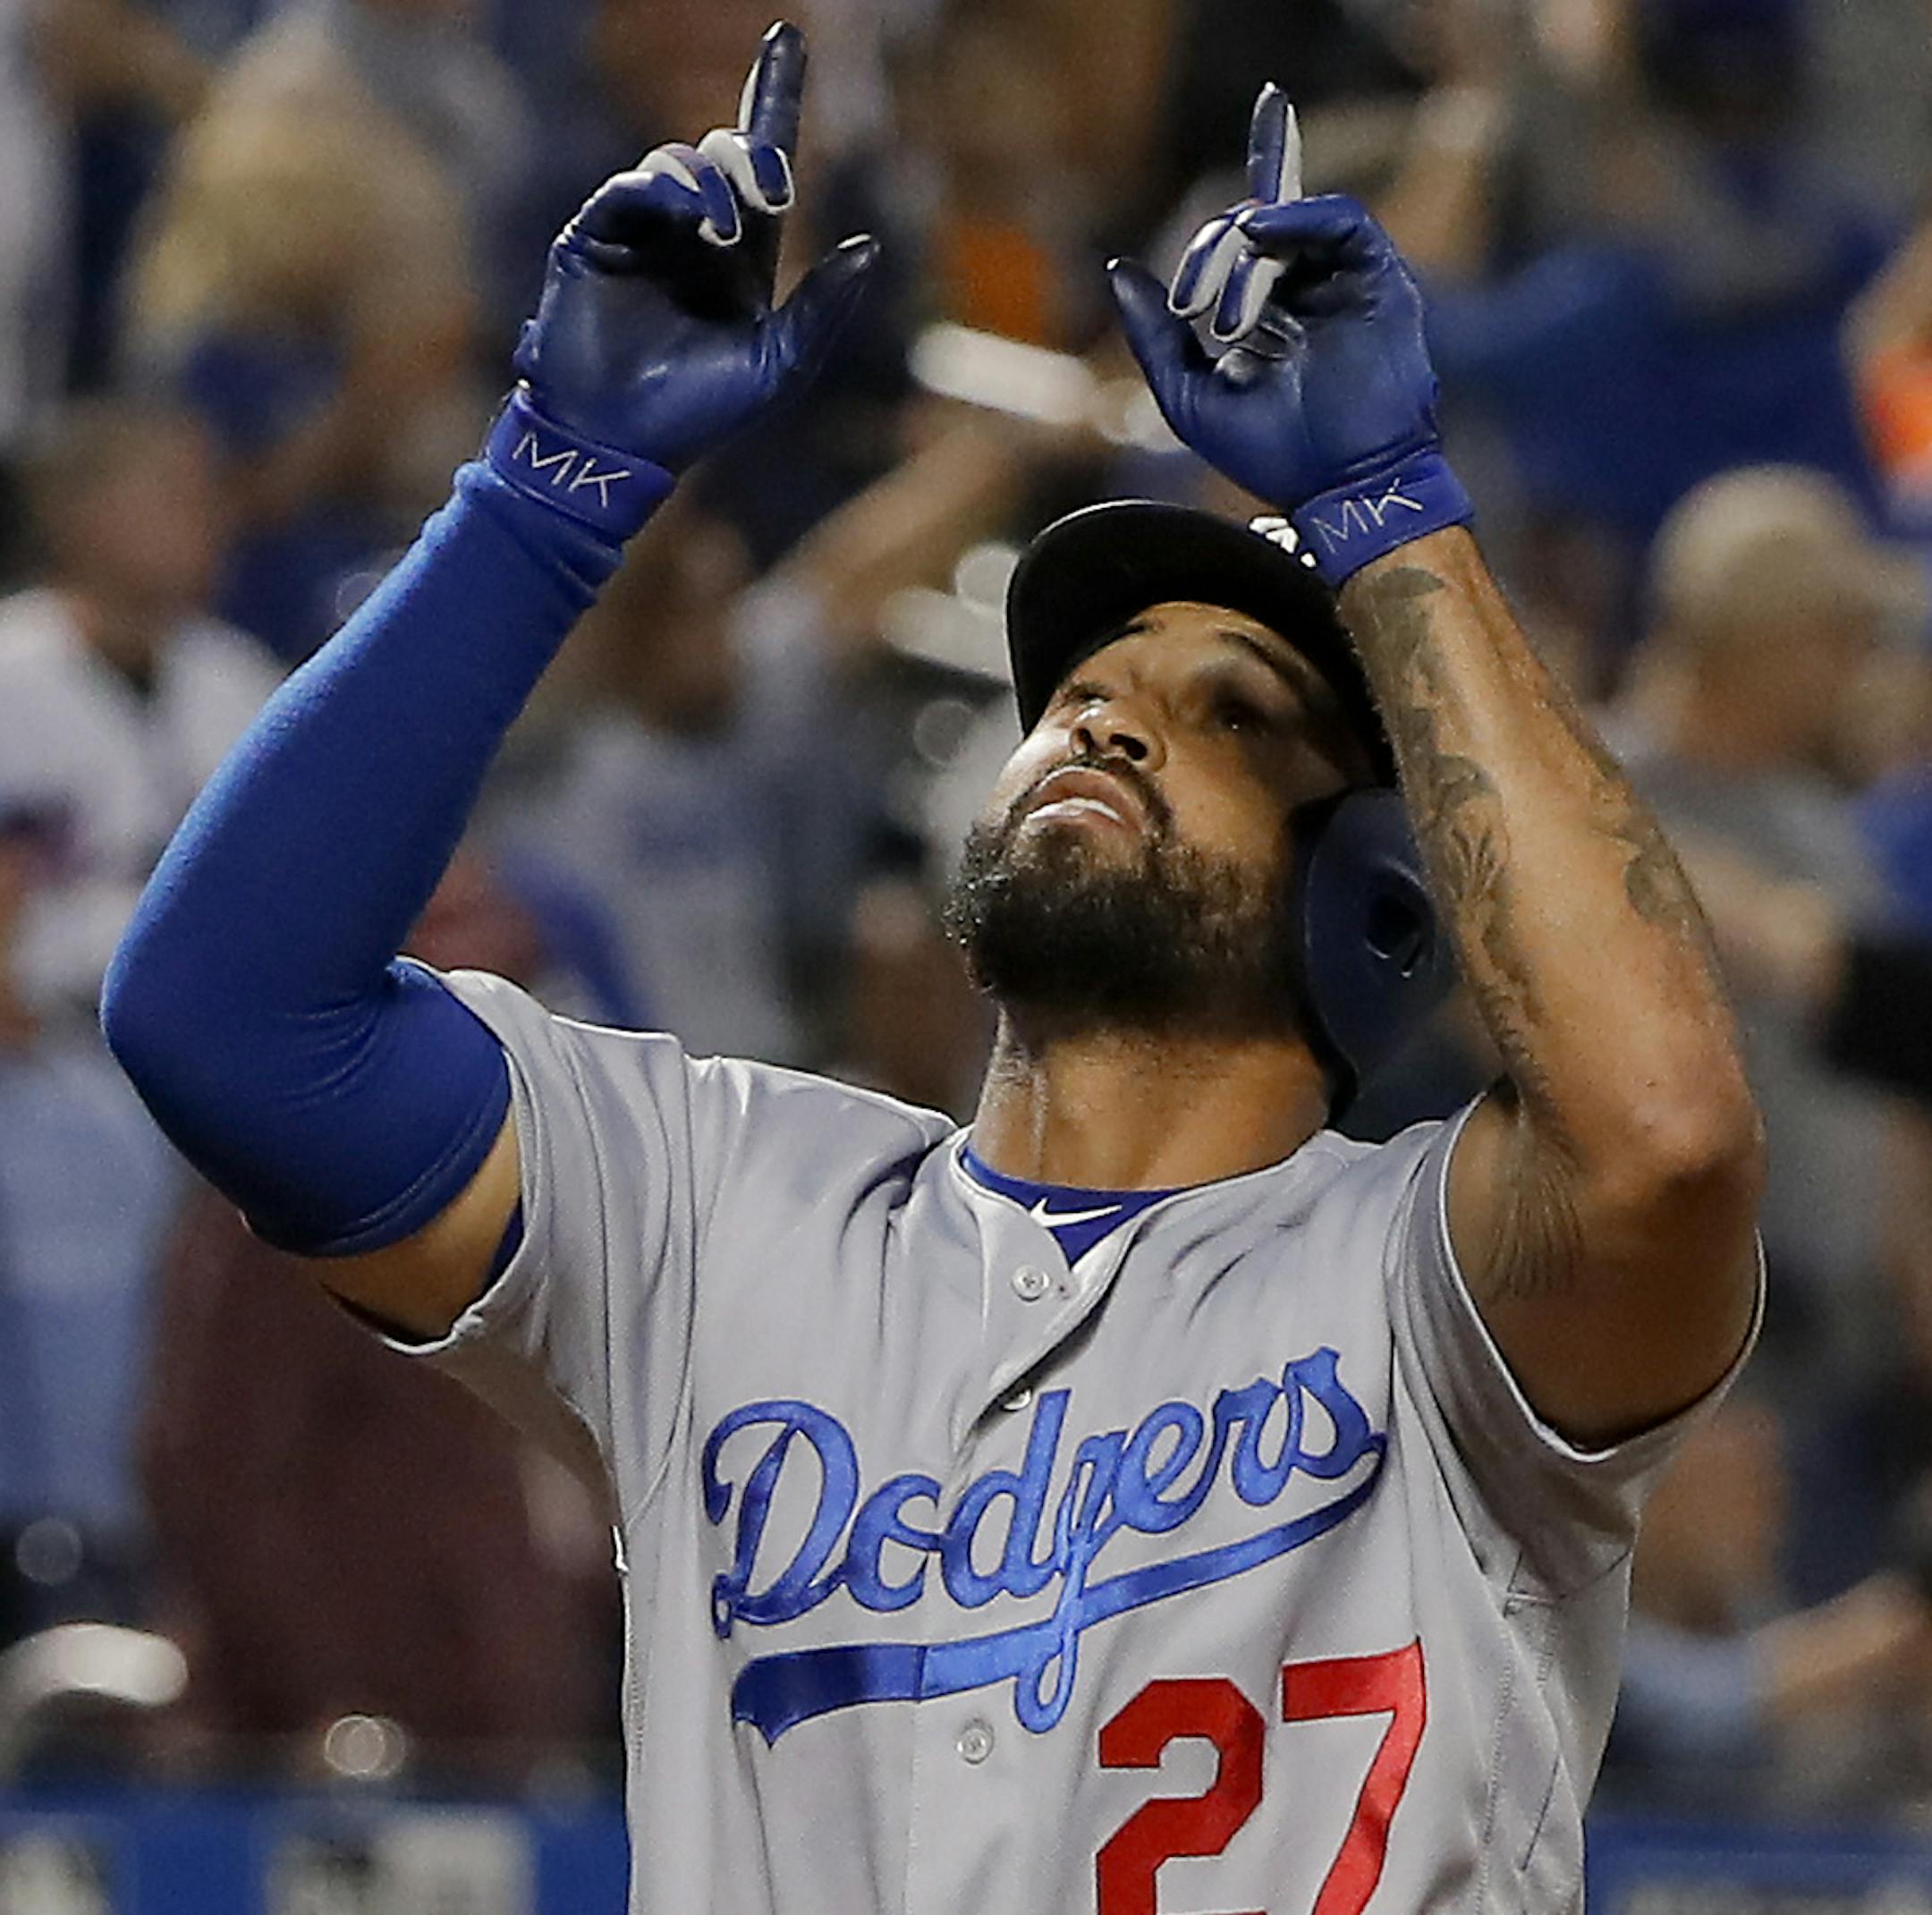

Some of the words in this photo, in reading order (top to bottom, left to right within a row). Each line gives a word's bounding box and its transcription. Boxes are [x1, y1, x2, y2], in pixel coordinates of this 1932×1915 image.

[512, 432, 631, 509] MK
[1310, 477, 1424, 555] MK
[701, 1346, 1388, 1733] Dodgers
[1095, 1636, 1427, 1915] 27
